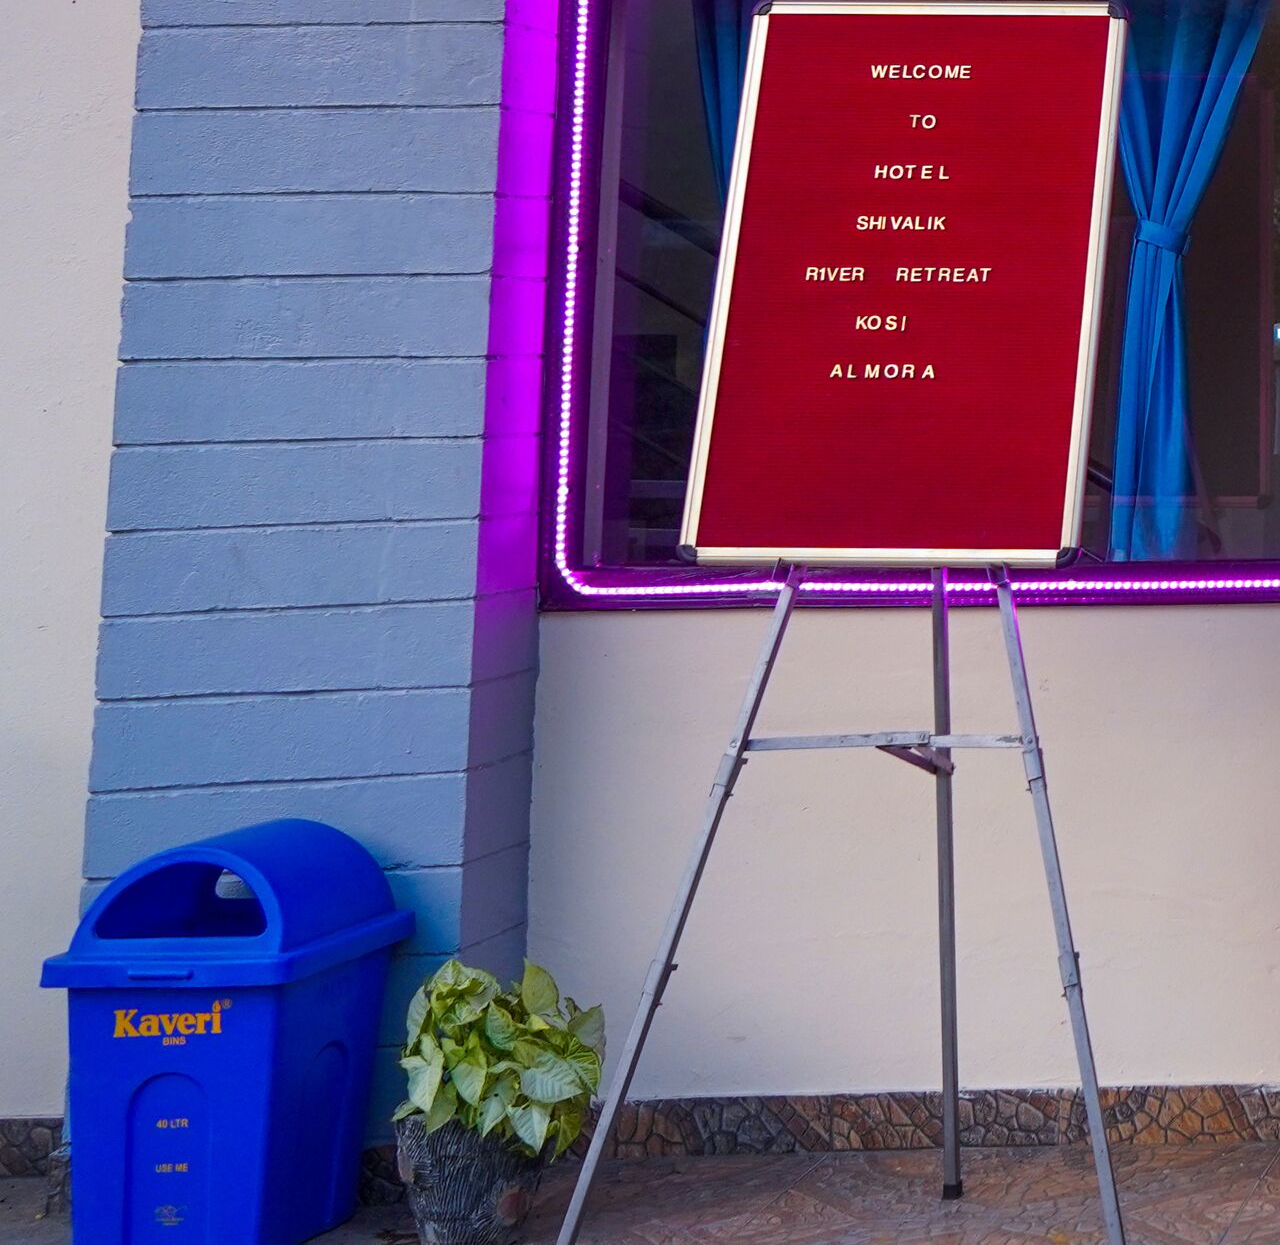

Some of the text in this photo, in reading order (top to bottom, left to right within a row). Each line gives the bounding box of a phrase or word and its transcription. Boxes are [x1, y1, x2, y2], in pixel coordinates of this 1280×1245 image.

[869, 63, 973, 80] WELCOME
[908, 114, 938, 130] TO
[873, 164, 951, 181] HOTEL
[855, 214, 947, 232] SHIVALIK
[894, 266, 993, 284] RETREAT
[854, 314, 908, 333] KOSI
[828, 362, 936, 380] ALMORA
[113, 1000, 223, 1039] Kaveri
[162, 1036, 188, 1047] BINS
